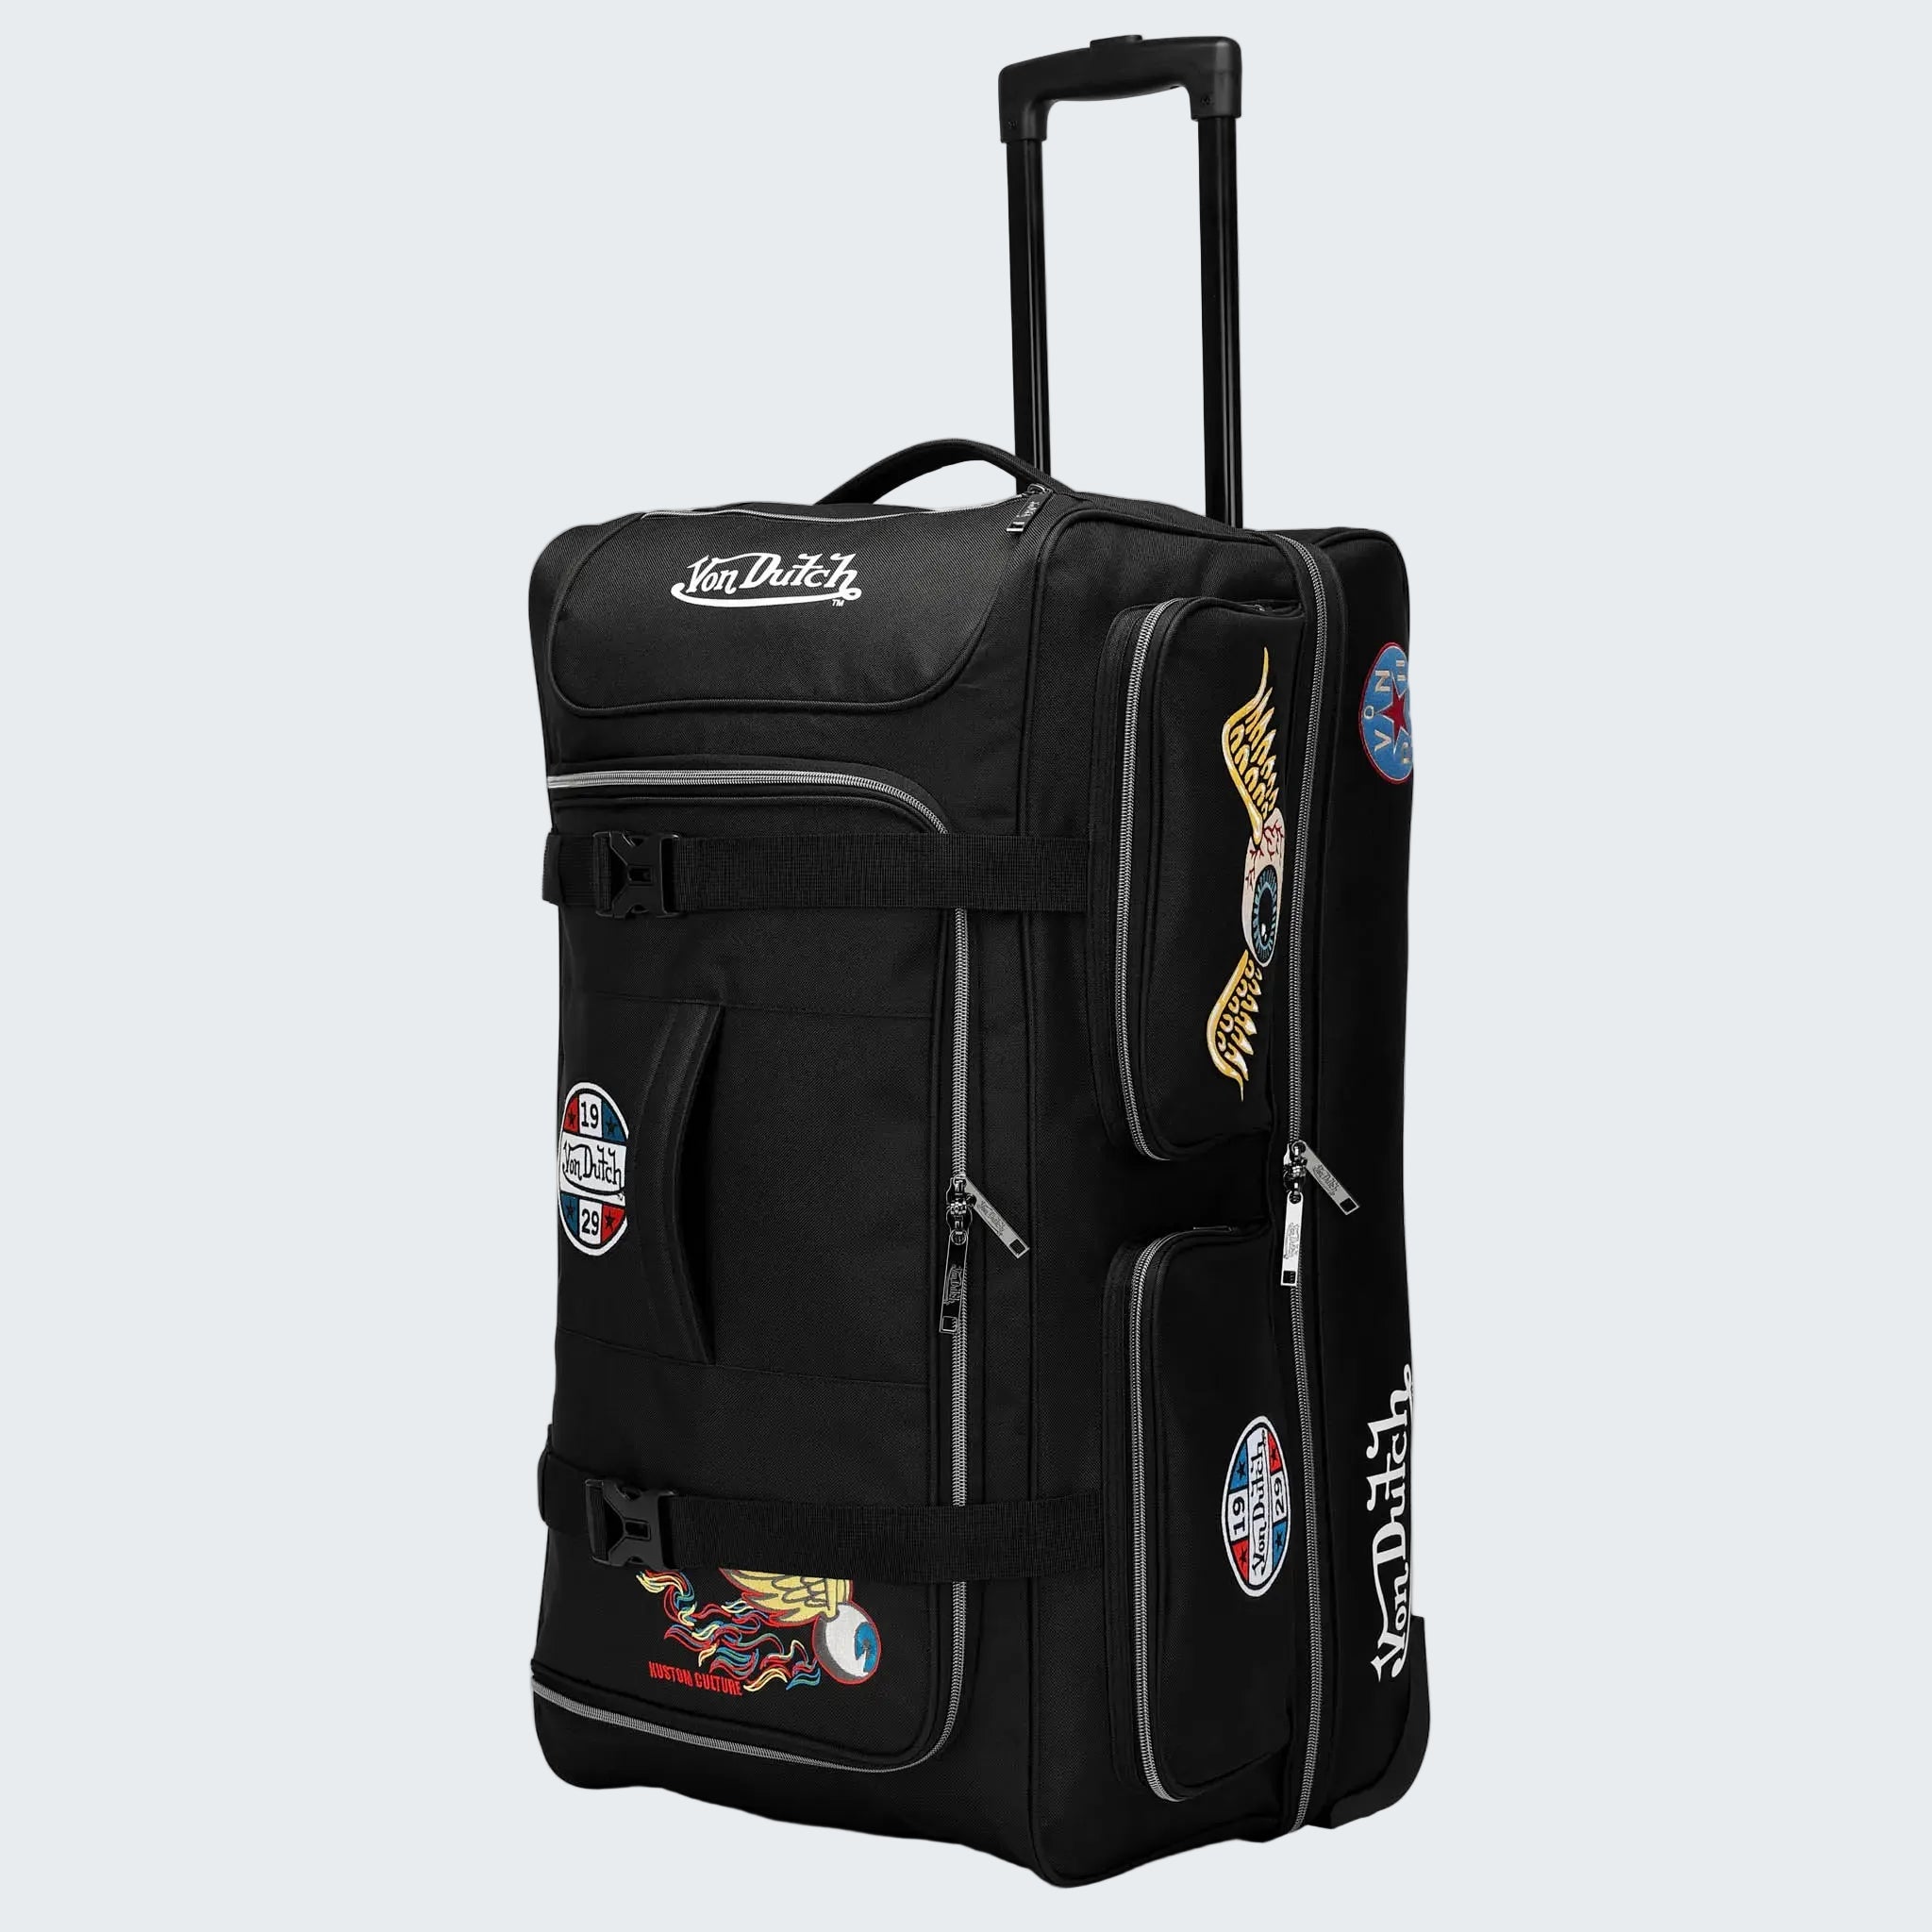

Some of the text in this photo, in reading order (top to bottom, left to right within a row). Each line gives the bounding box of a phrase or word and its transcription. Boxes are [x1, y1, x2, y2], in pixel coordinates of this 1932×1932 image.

[686, 552, 861, 600] Von Dutch
[1363, 670, 1392, 752] VON
[581, 1101, 599, 1129] 19
[563, 1140, 624, 1186] Von Dutch
[581, 1208, 600, 1236] 29
[1233, 1496, 1245, 1536] 19
[1251, 1441, 1268, 1576] Von Dutch
[1274, 1477, 1285, 1517] 29
[1366, 1364, 1412, 1682] Von Dutch
[648, 1661, 742, 1696] KUSTOM CULTURE
